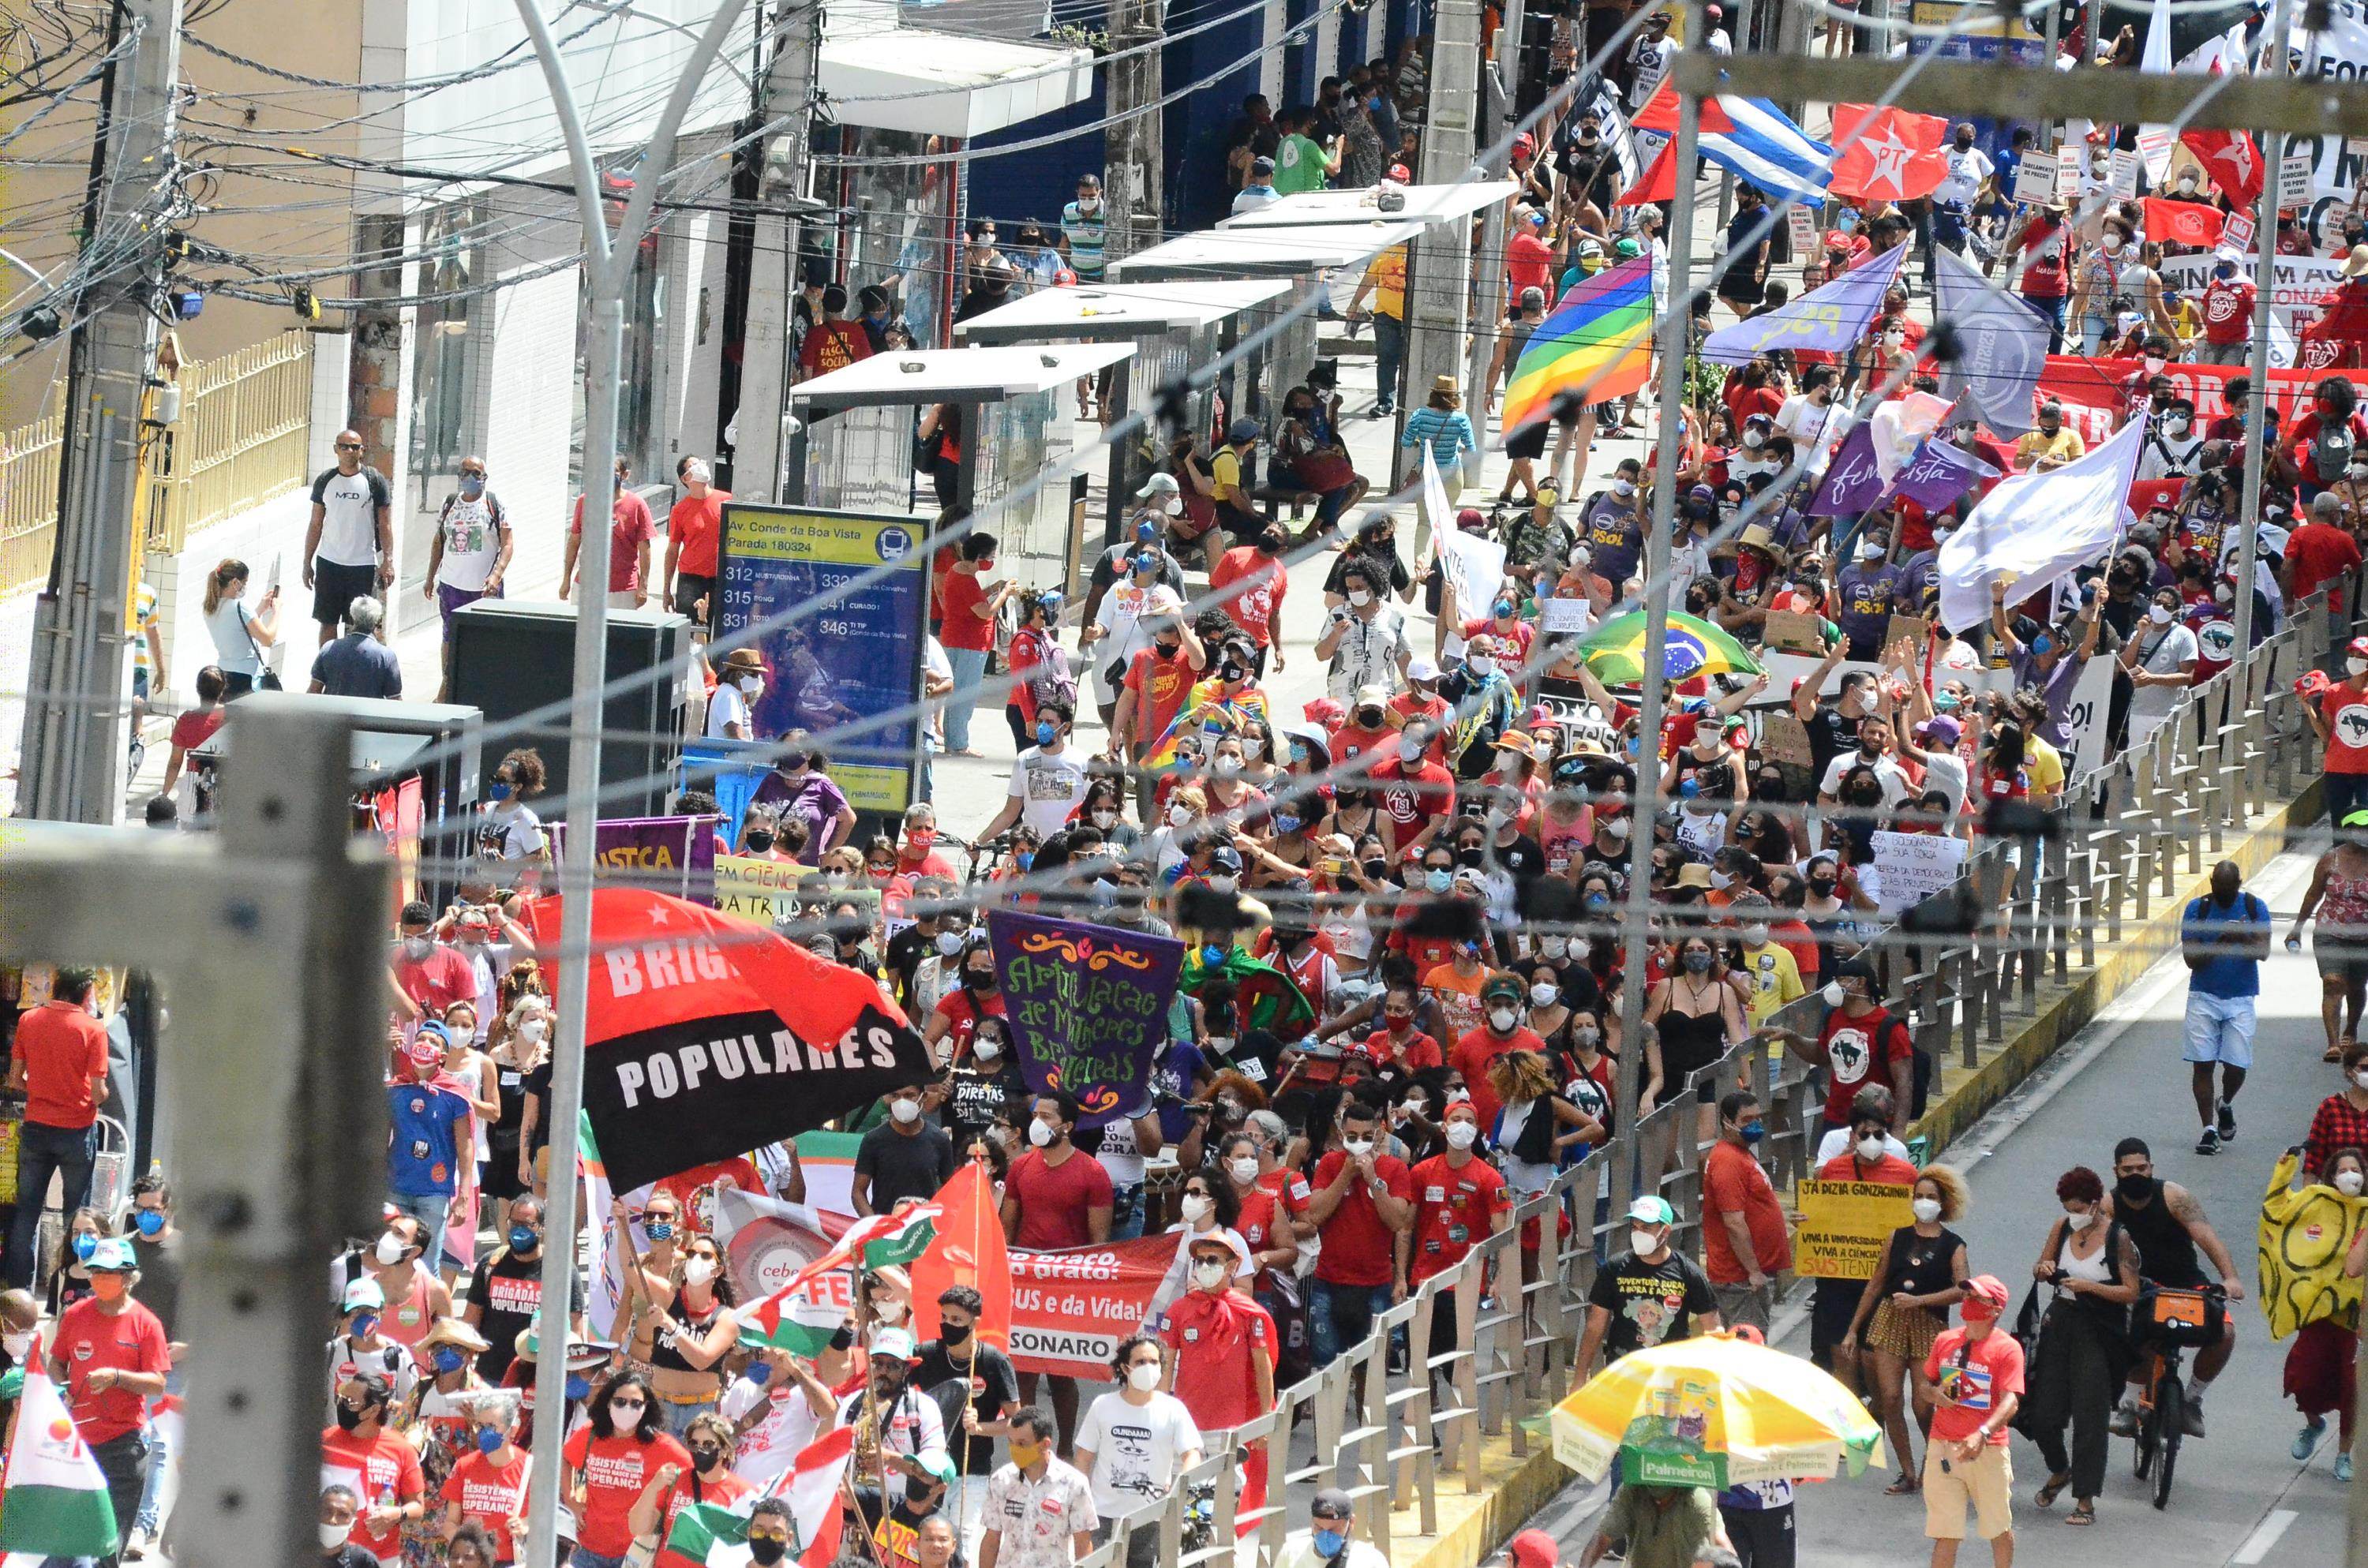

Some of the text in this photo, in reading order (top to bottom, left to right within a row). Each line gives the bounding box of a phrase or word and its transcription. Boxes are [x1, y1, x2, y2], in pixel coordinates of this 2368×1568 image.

[1878, 146, 1906, 171] PT
[2022, 161, 2055, 174] TABELAMENTO
[2031, 171, 2050, 180] PREÇOS
[729, 521, 861, 540] Av. Conde da Boa Vista
[1592, 529, 1624, 546] PSOL
[728, 537, 811, 552] Parada 180324
[725, 567, 753, 582] 312
[755, 572, 800, 582] MUSTARDINHA
[822, 574, 849, 588] 332
[723, 590, 751, 604] 315
[849, 602, 877, 611] CURADO
[722, 613, 749, 627] 331
[819, 620, 849, 635] 346
[1680, 829, 1696, 840] EU
[1018, 1000, 1048, 1026] de
[957, 1087, 1006, 1103] DIRETAS
[1821, 1183, 1849, 1196] DIZIA
[1802, 1232, 1822, 1244] VIVA
[1822, 1233, 1830, 1244] A
[1813, 1246, 1838, 1257] VIVA
[1840, 1248, 1847, 1257] A
[1617, 1277, 1660, 1288] JUVENTUDE
[491, 1283, 542, 1303] BRIGADAS
[490, 1299, 541, 1315] POPULARES
[1044, 1297, 1057, 1314] e
[1061, 1293, 1085, 1317] da
[1088, 1296, 1144, 1322] Vida!
[1646, 1461, 1713, 1482] Palmeiron
